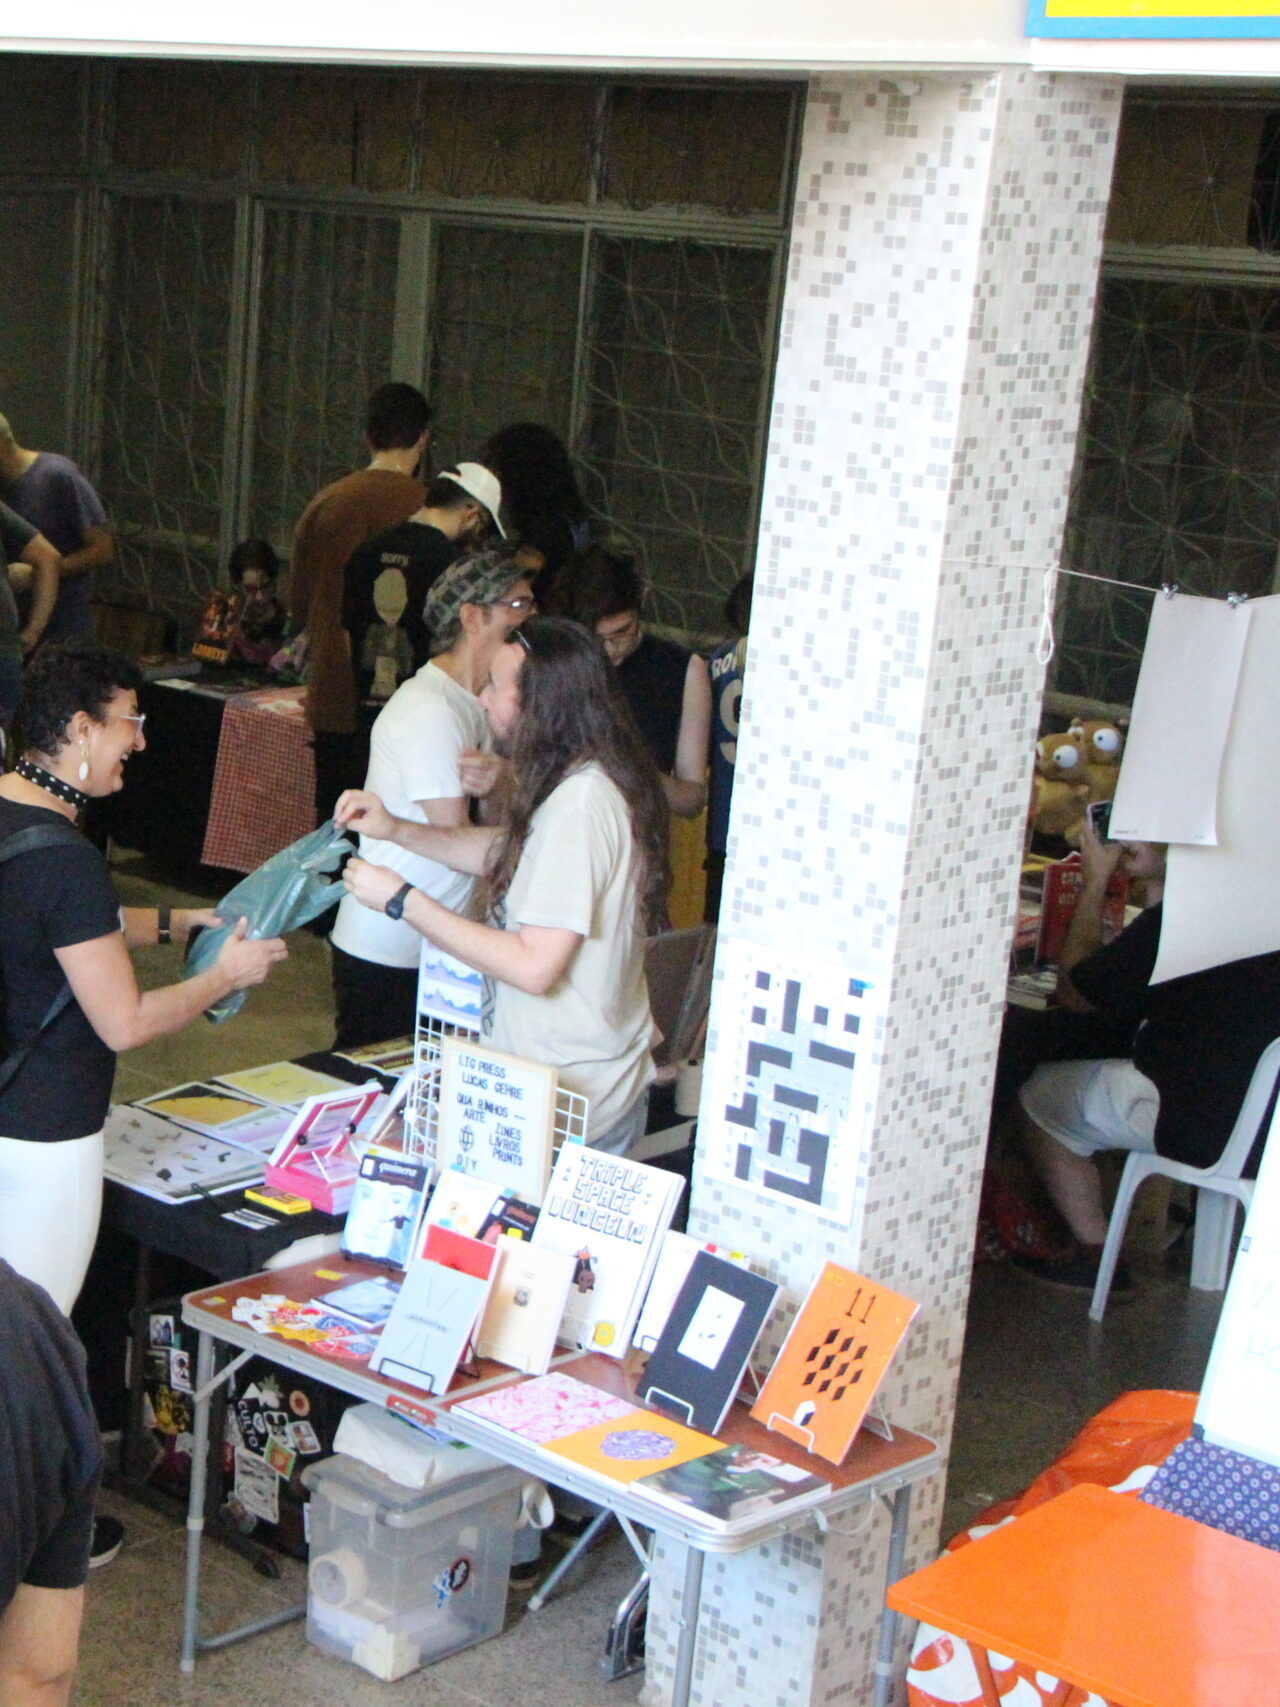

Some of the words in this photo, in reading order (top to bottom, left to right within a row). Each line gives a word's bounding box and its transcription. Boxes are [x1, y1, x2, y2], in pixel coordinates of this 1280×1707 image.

[478, 1060, 506, 1079] PRESS
[462, 1072, 488, 1090] LUCAS
[463, 1108, 486, 1123] ARTE
[495, 1121, 522, 1140] ZINES
[489, 1134, 521, 1153] LIVROS
[492, 1148, 523, 1167] PRINTS
[572, 1178, 636, 1216] SPACE
